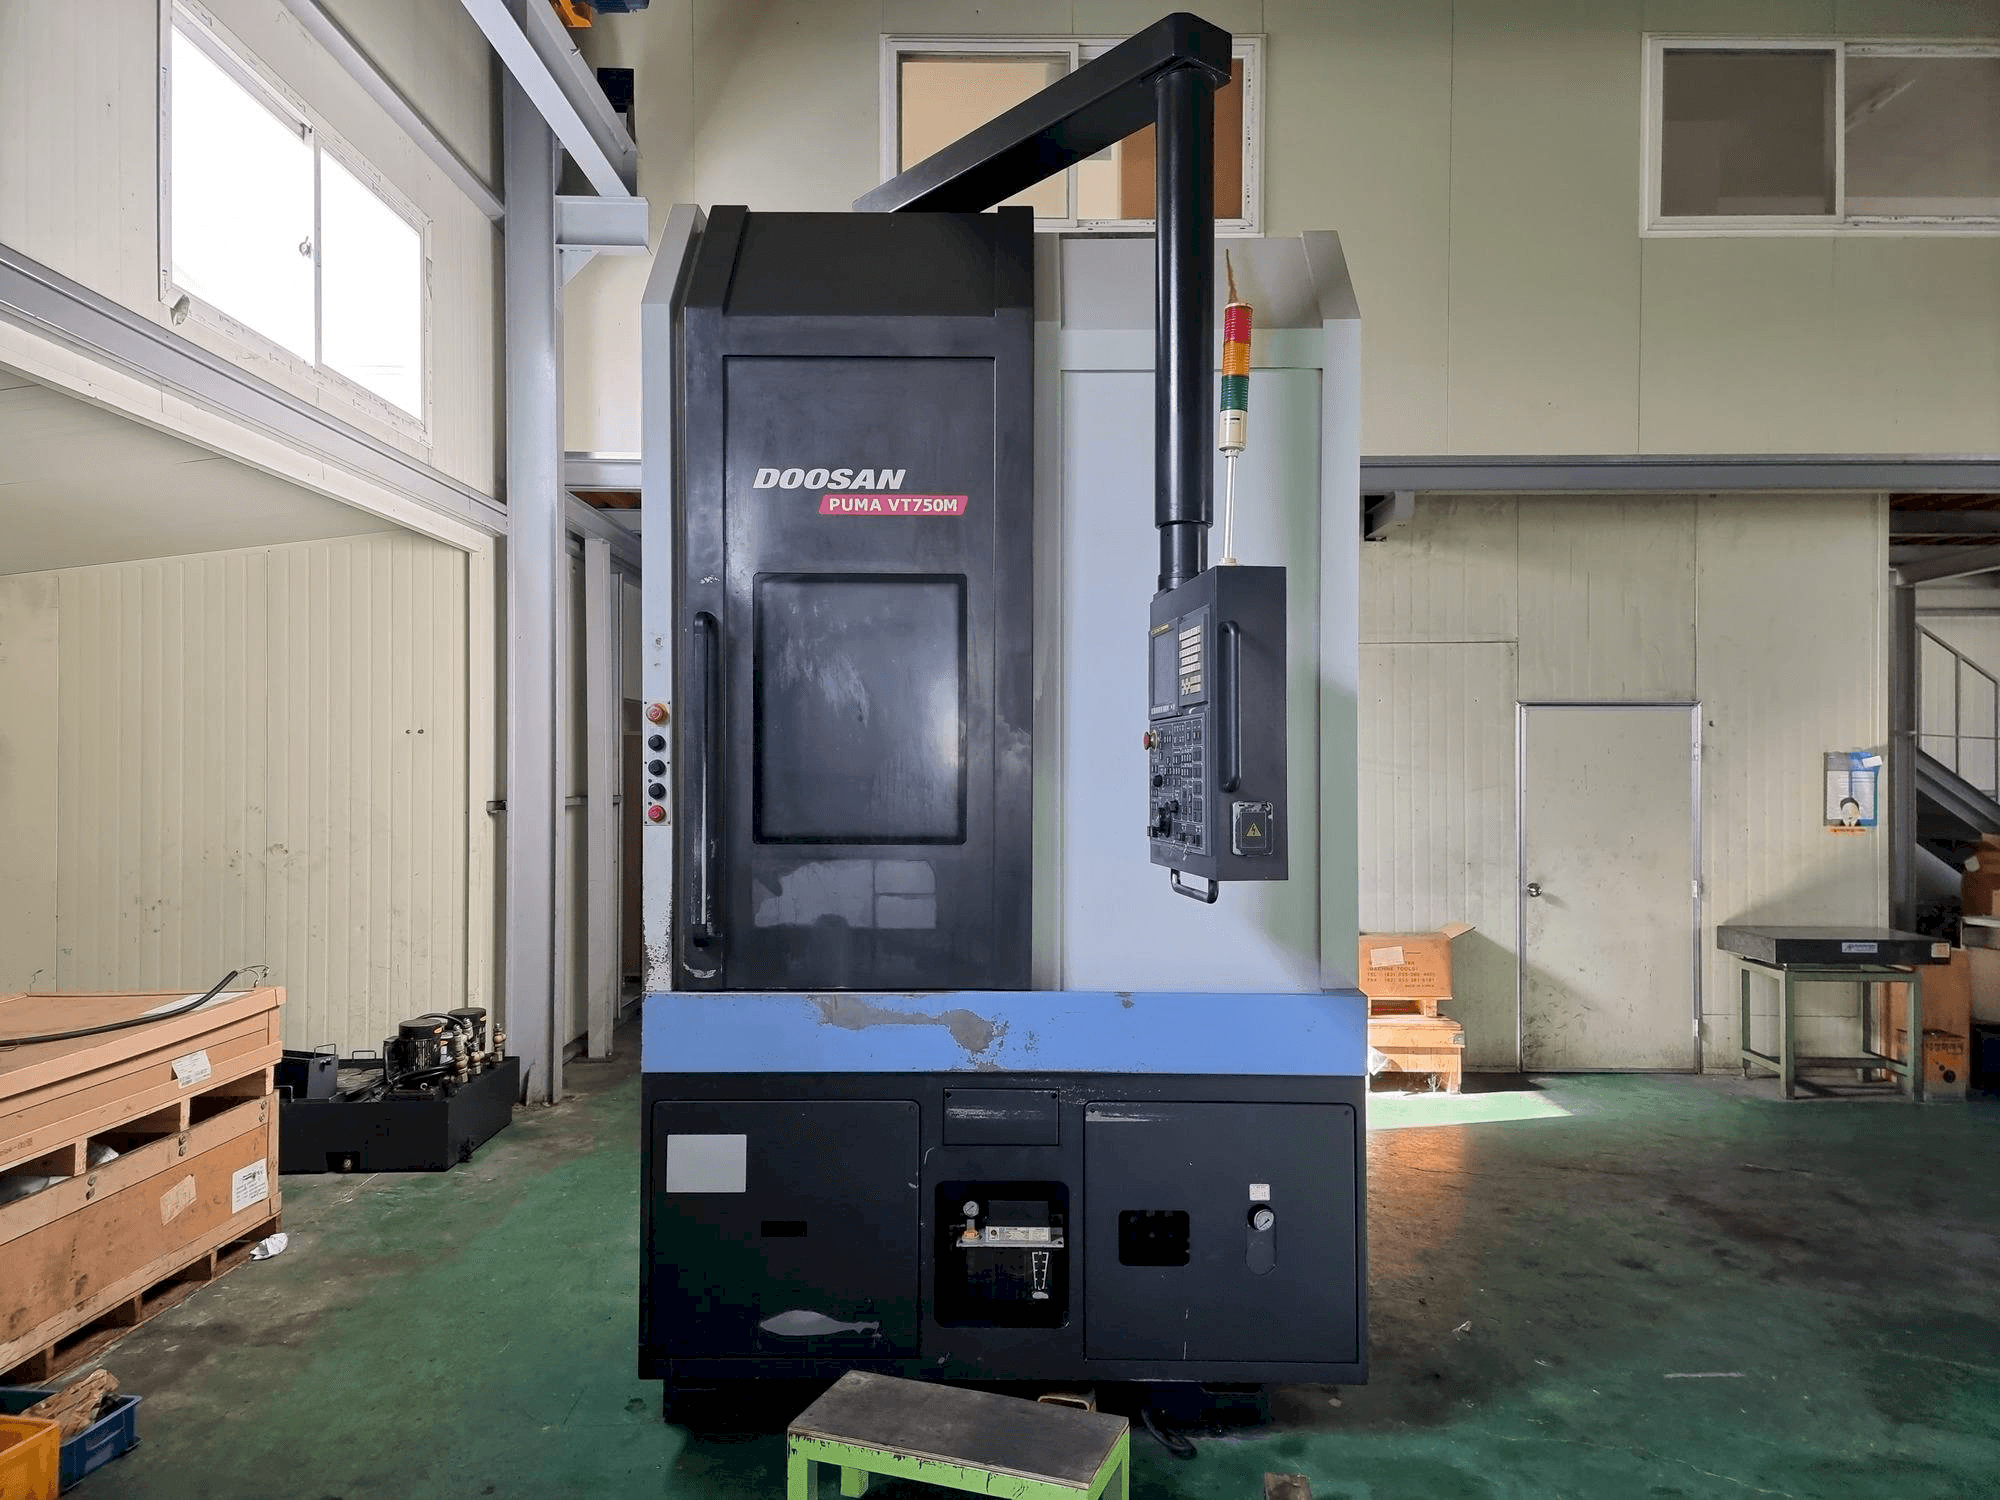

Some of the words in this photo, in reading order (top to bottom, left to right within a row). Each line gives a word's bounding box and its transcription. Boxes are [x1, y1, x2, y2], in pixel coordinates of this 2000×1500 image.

[753, 468, 906, 489] DOOSAN
[829, 498, 881, 512] PUMA
[888, 498, 958, 512] VT750M
